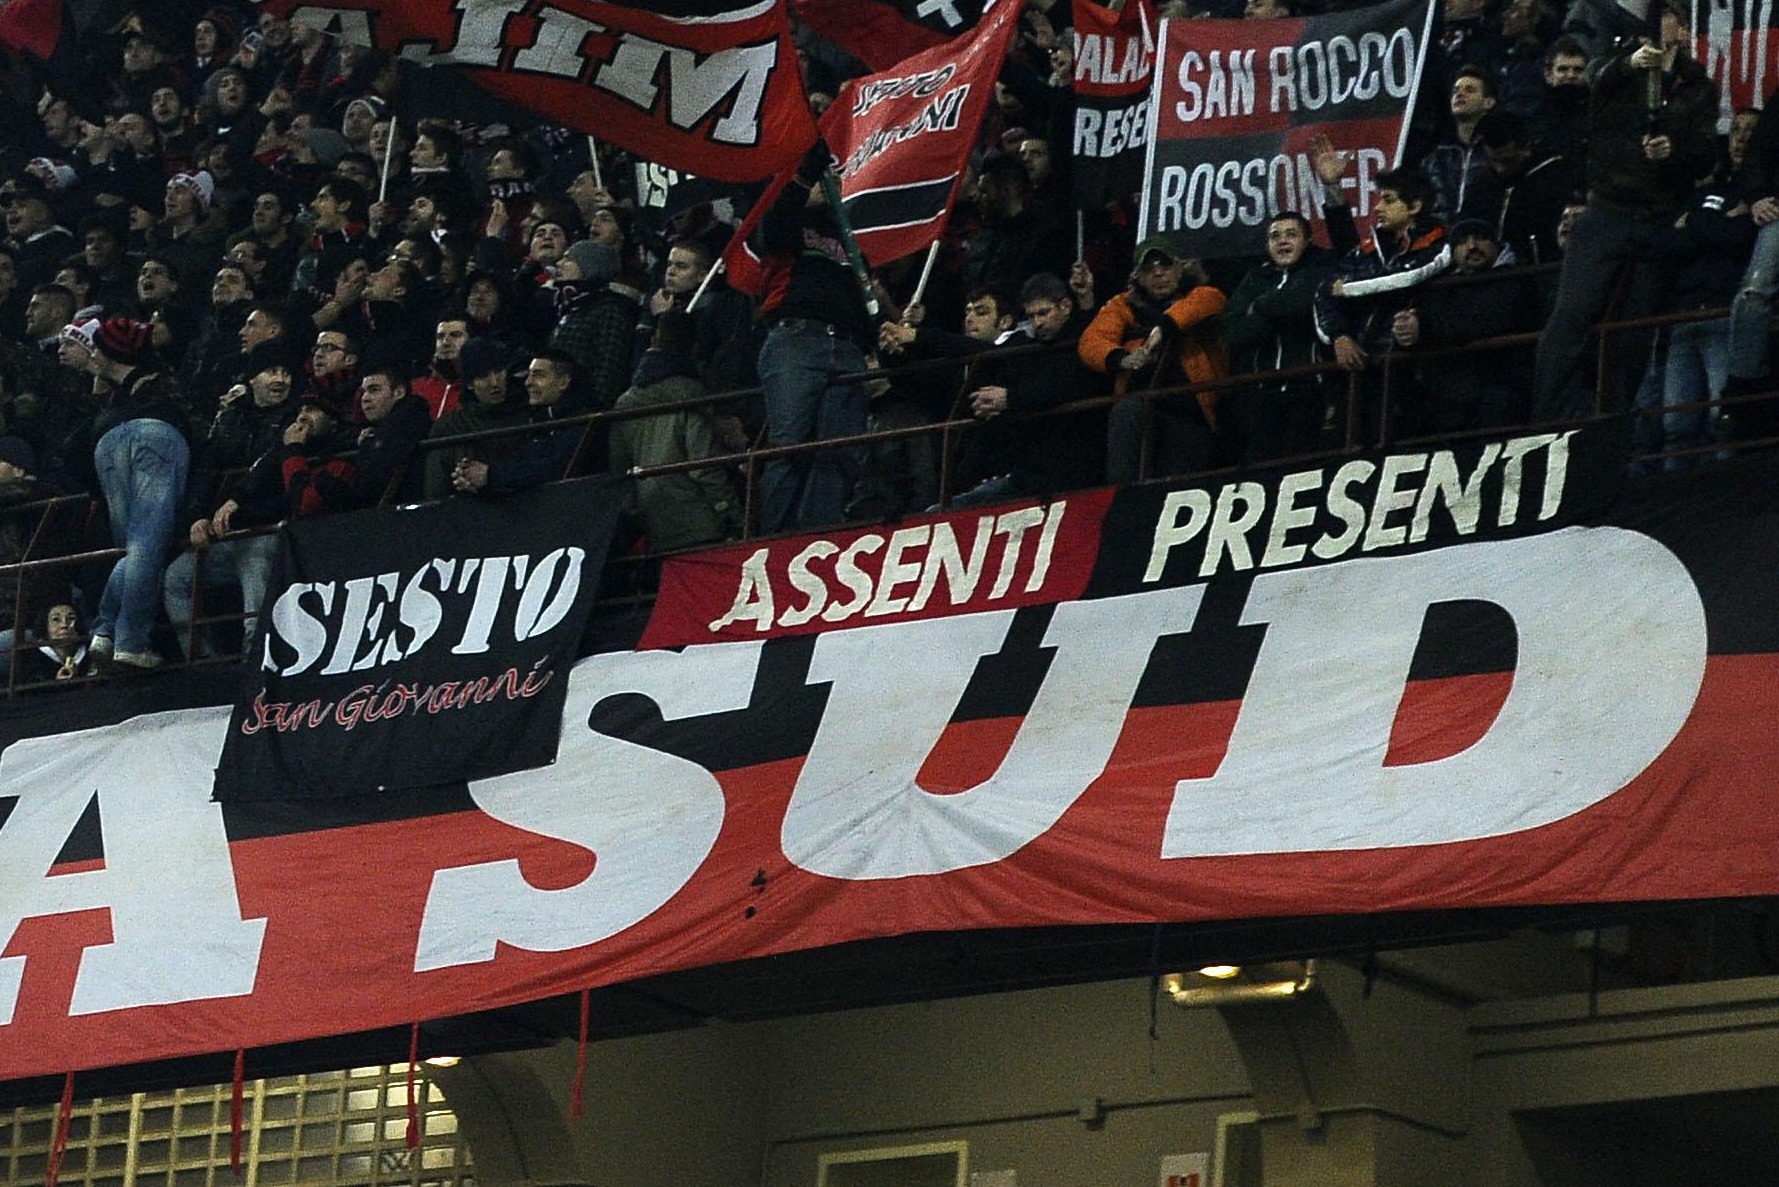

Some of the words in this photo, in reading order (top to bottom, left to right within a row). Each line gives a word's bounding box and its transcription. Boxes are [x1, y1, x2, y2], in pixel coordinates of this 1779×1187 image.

[1175, 47, 1257, 123] SAN
[1270, 26, 1417, 113] ROCCO
[708, 500, 1067, 633] ASSENTI
[1142, 429, 1583, 584] PRESENTI
[261, 546, 586, 678] SESTO
[241, 687, 334, 736] San
[335, 654, 555, 732] Giovanni
[414, 524, 1710, 973] SUD
